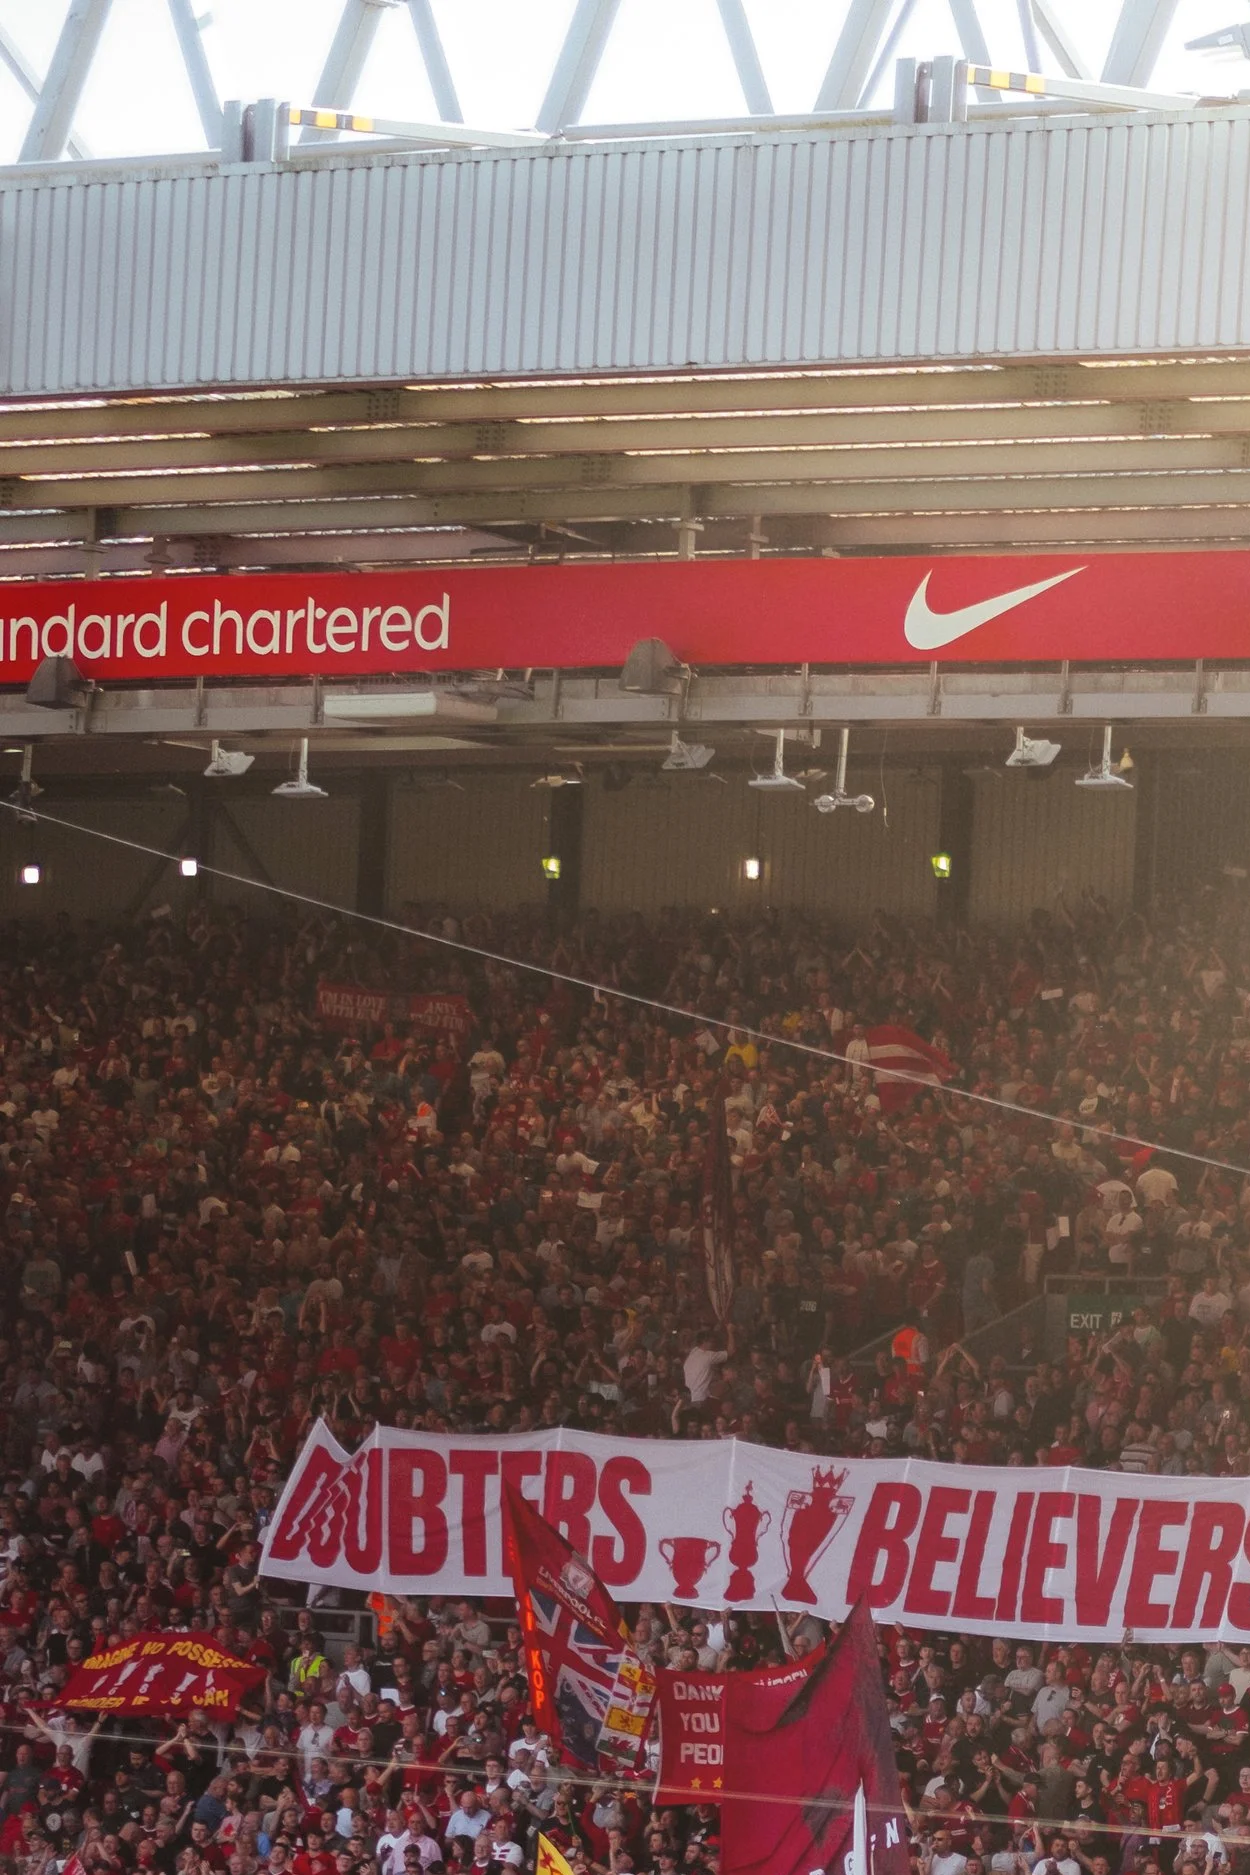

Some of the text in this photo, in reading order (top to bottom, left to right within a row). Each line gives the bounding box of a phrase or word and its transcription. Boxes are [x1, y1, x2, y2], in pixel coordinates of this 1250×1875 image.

[181, 593, 450, 656] chartered
[1070, 1314, 1102, 1330] EXIT
[530, 1649, 546, 1711] KOP
[672, 1681, 724, 1702] DANK
[679, 1713, 719, 1734] YOU
